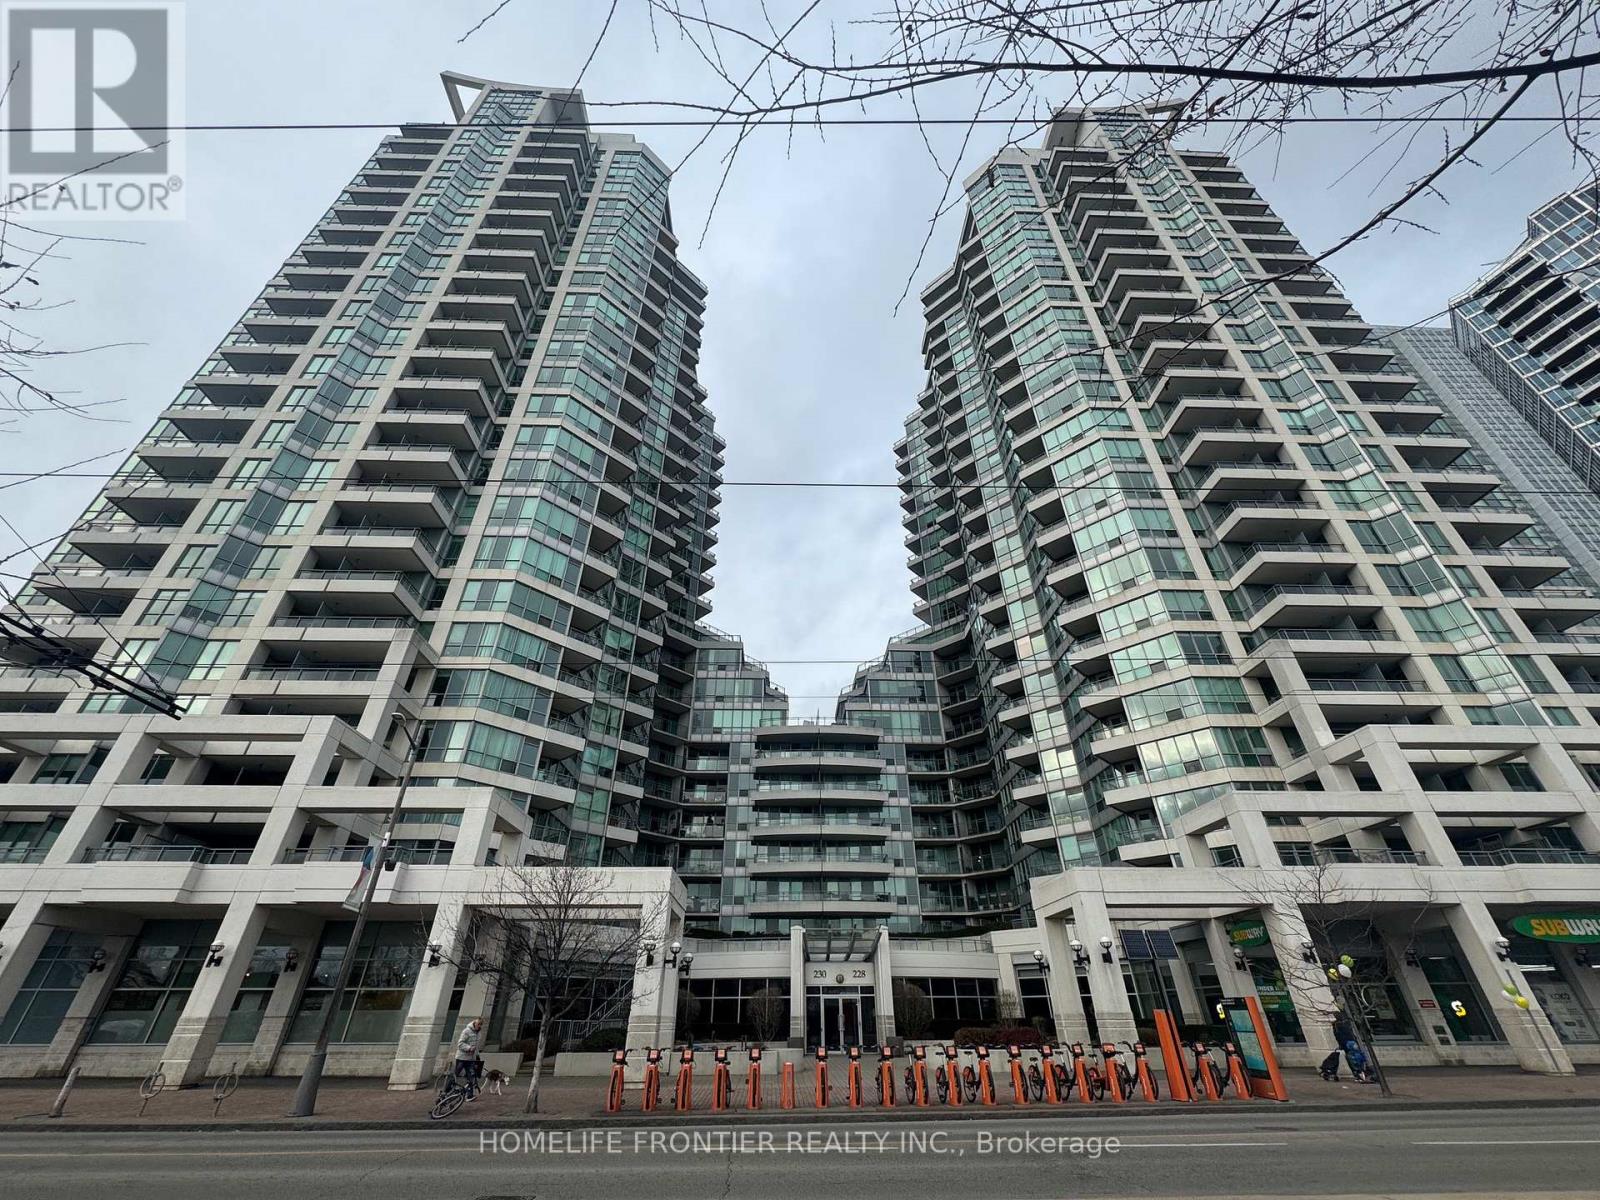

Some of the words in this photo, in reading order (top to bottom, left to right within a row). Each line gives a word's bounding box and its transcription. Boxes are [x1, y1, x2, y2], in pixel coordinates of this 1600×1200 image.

[1233, 926, 1263, 942] SUBWAY
[813, 970, 827, 978] 230
[853, 970, 866, 978] 228
